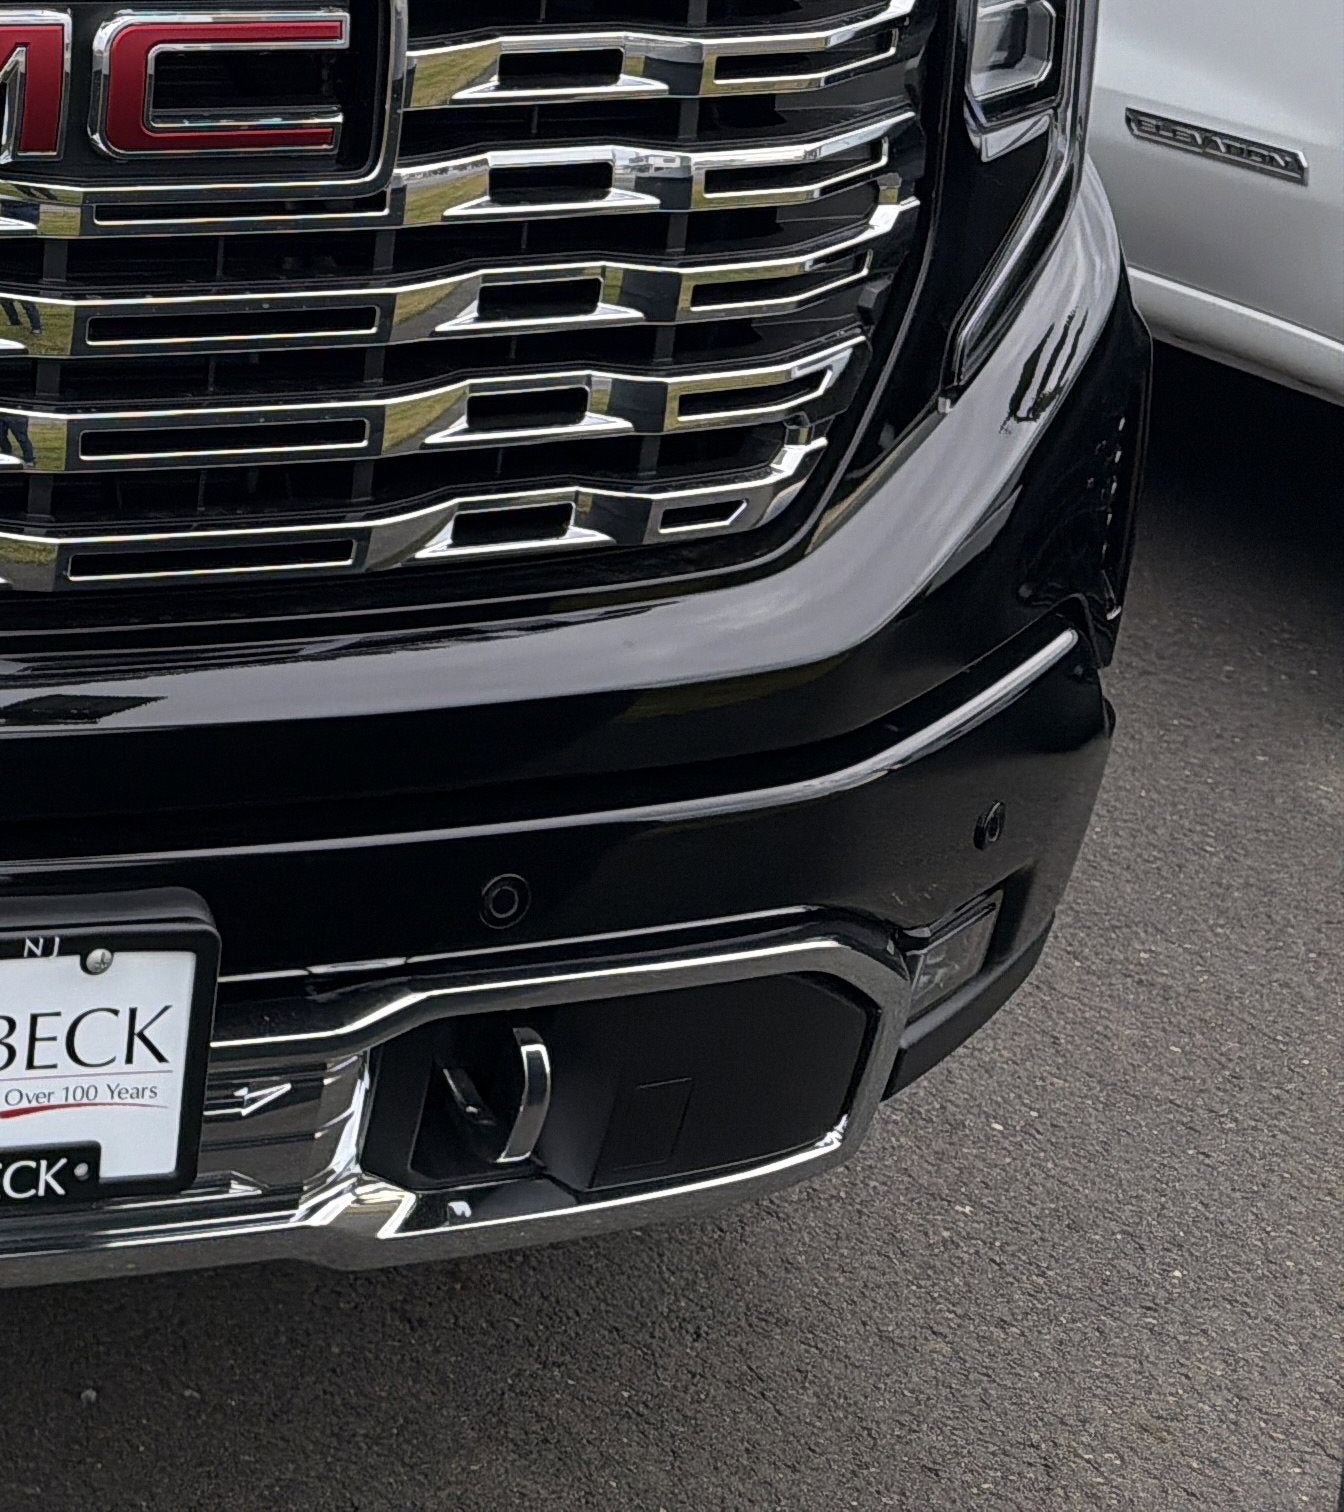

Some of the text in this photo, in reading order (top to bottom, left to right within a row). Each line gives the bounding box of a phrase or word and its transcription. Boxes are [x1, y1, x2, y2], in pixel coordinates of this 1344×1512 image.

[1138, 117, 1293, 168] ELEVATION
[24, 936, 62, 959] NJ
[4, 1087, 55, 1107] Over
[62, 1084, 99, 1103] 100
[106, 1082, 159, 1102] Years
